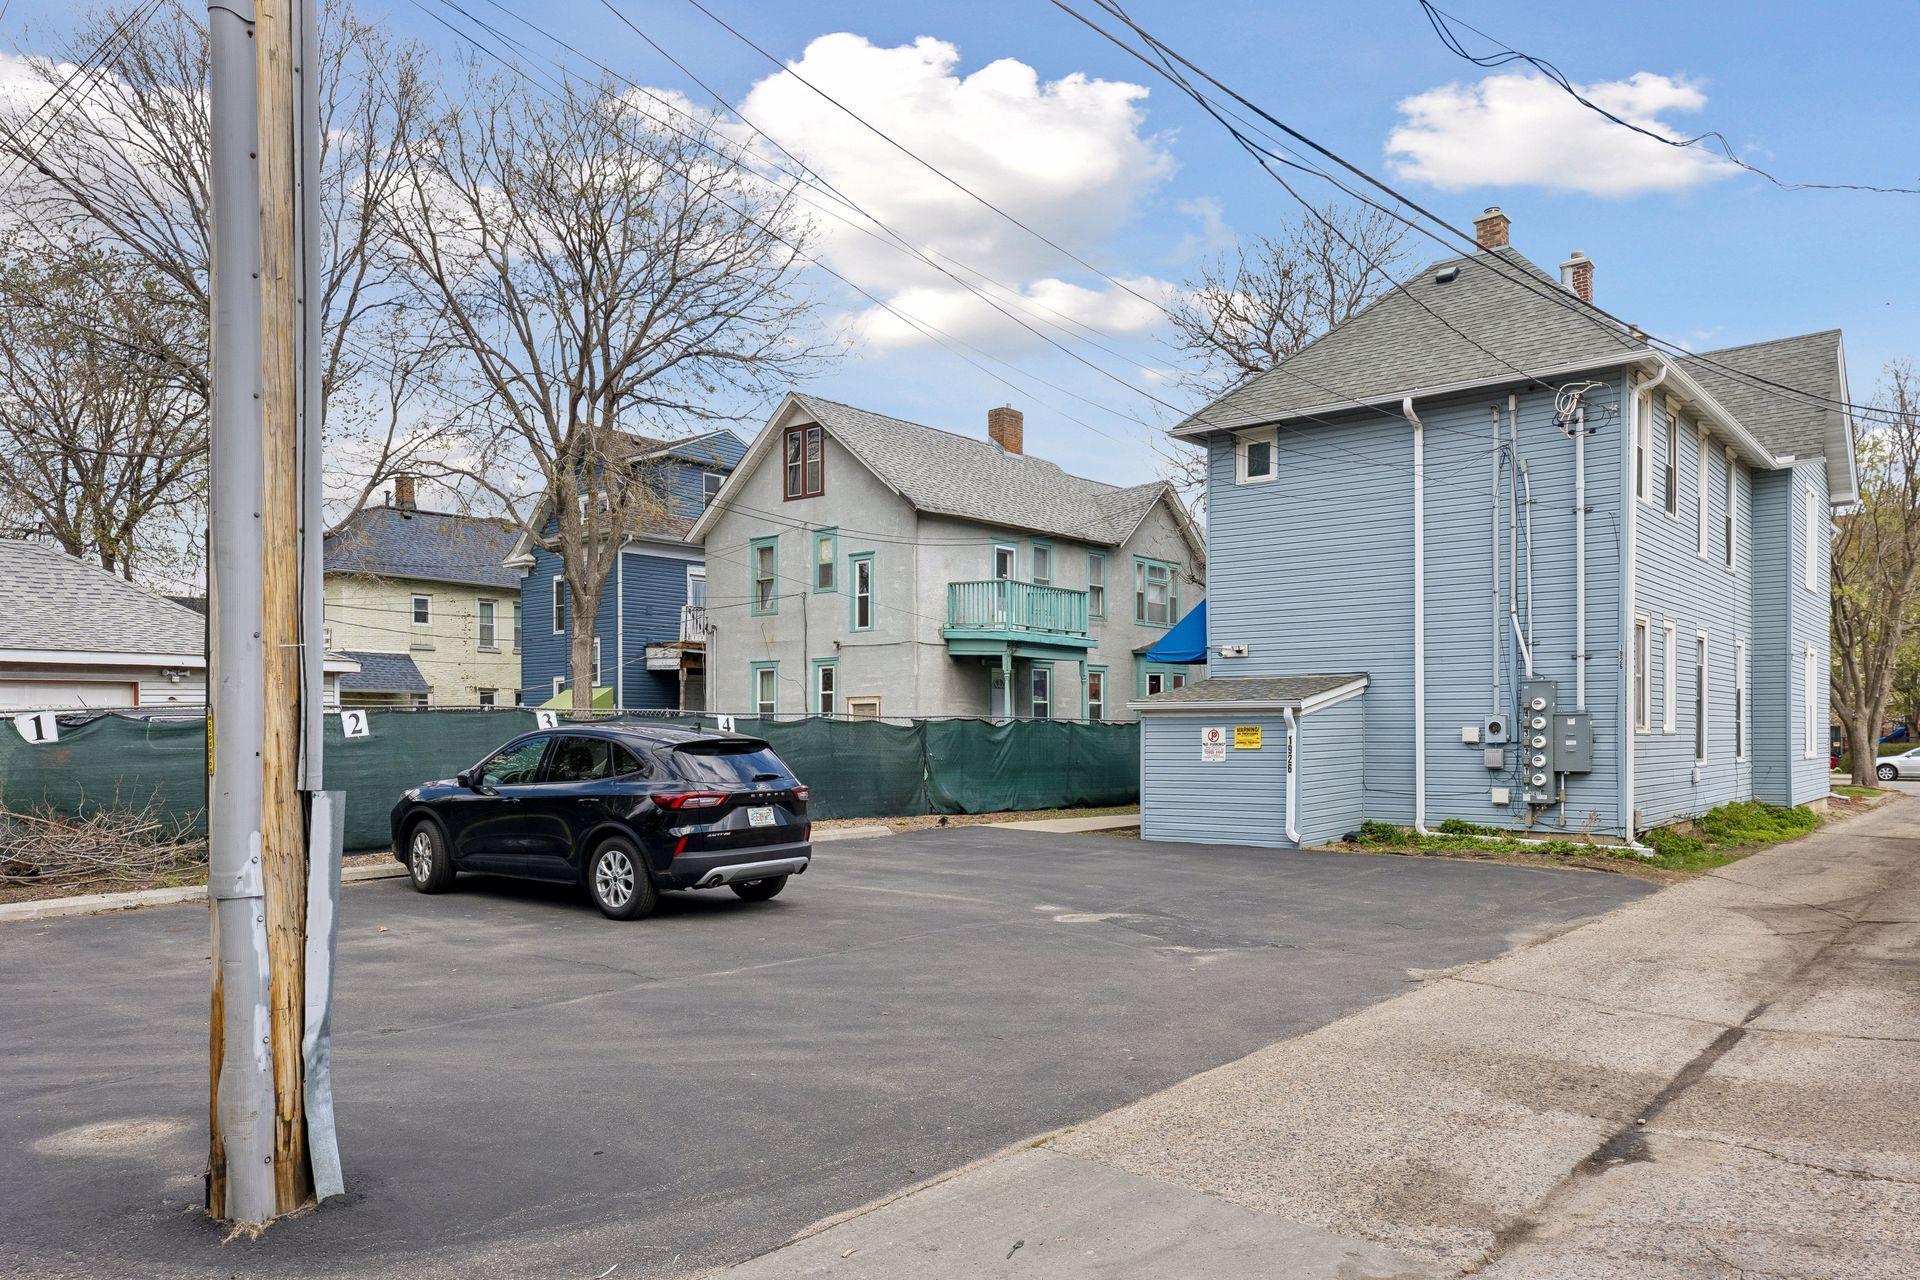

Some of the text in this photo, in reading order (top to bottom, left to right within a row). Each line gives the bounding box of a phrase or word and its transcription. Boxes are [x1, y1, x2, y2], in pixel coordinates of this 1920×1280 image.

[29, 715, 48, 740] 1
[348, 713, 362, 734] 2
[542, 713, 553, 728] 3
[722, 717, 731, 731] 4
